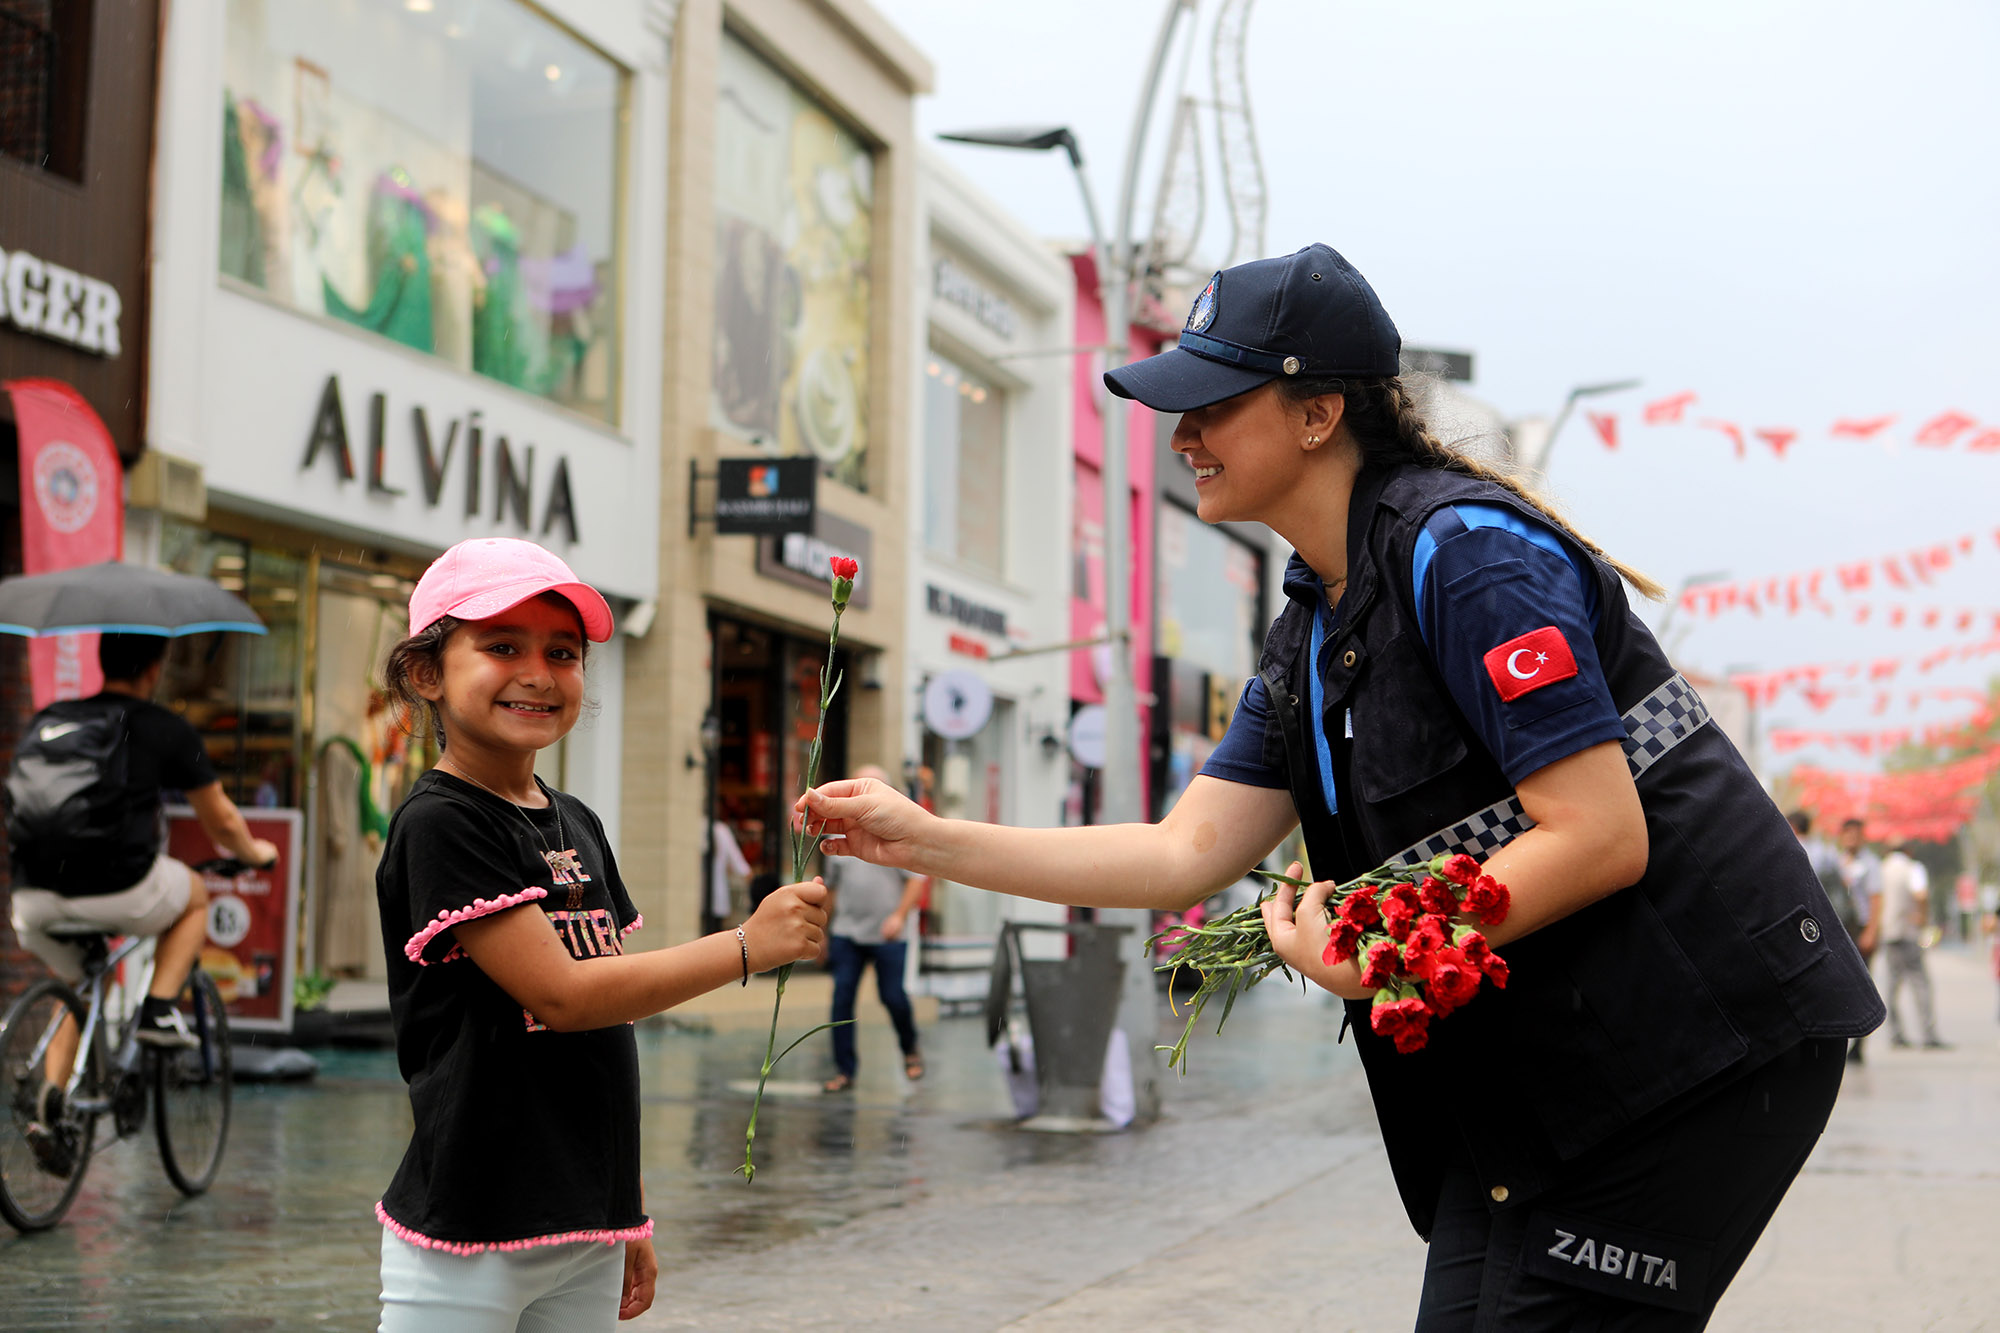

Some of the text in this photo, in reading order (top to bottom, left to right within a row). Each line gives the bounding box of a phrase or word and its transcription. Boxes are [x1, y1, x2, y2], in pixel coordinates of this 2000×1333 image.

[0, 246, 121, 355] GER
[302, 374, 579, 544] ALVİNA
[546, 908, 624, 957] ETTER
[1548, 1229, 1678, 1291] ZABITA
